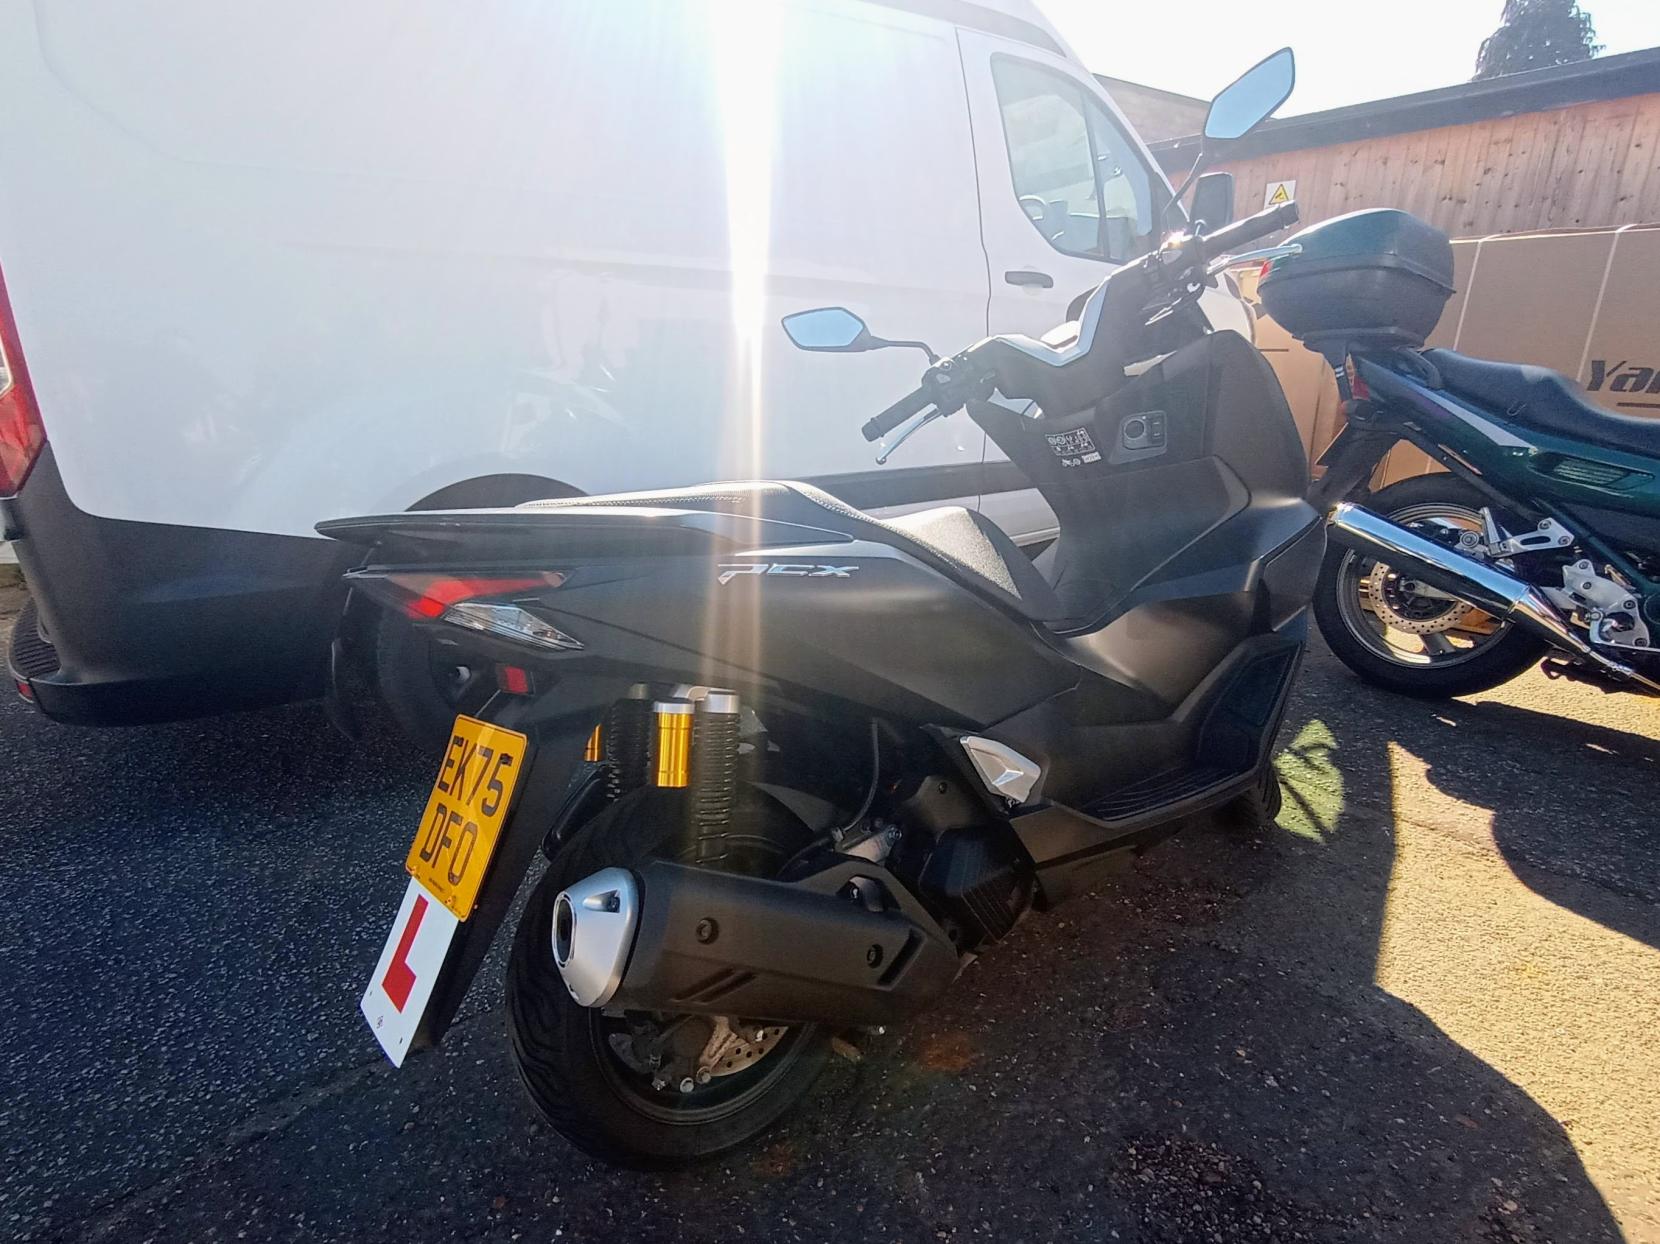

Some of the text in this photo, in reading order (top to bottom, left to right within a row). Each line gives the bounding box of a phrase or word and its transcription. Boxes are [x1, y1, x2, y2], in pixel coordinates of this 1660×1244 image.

[718, 563, 860, 585] PCX
[437, 735, 514, 818] EK75
[419, 803, 479, 886] DFO
[381, 893, 430, 1014] L
